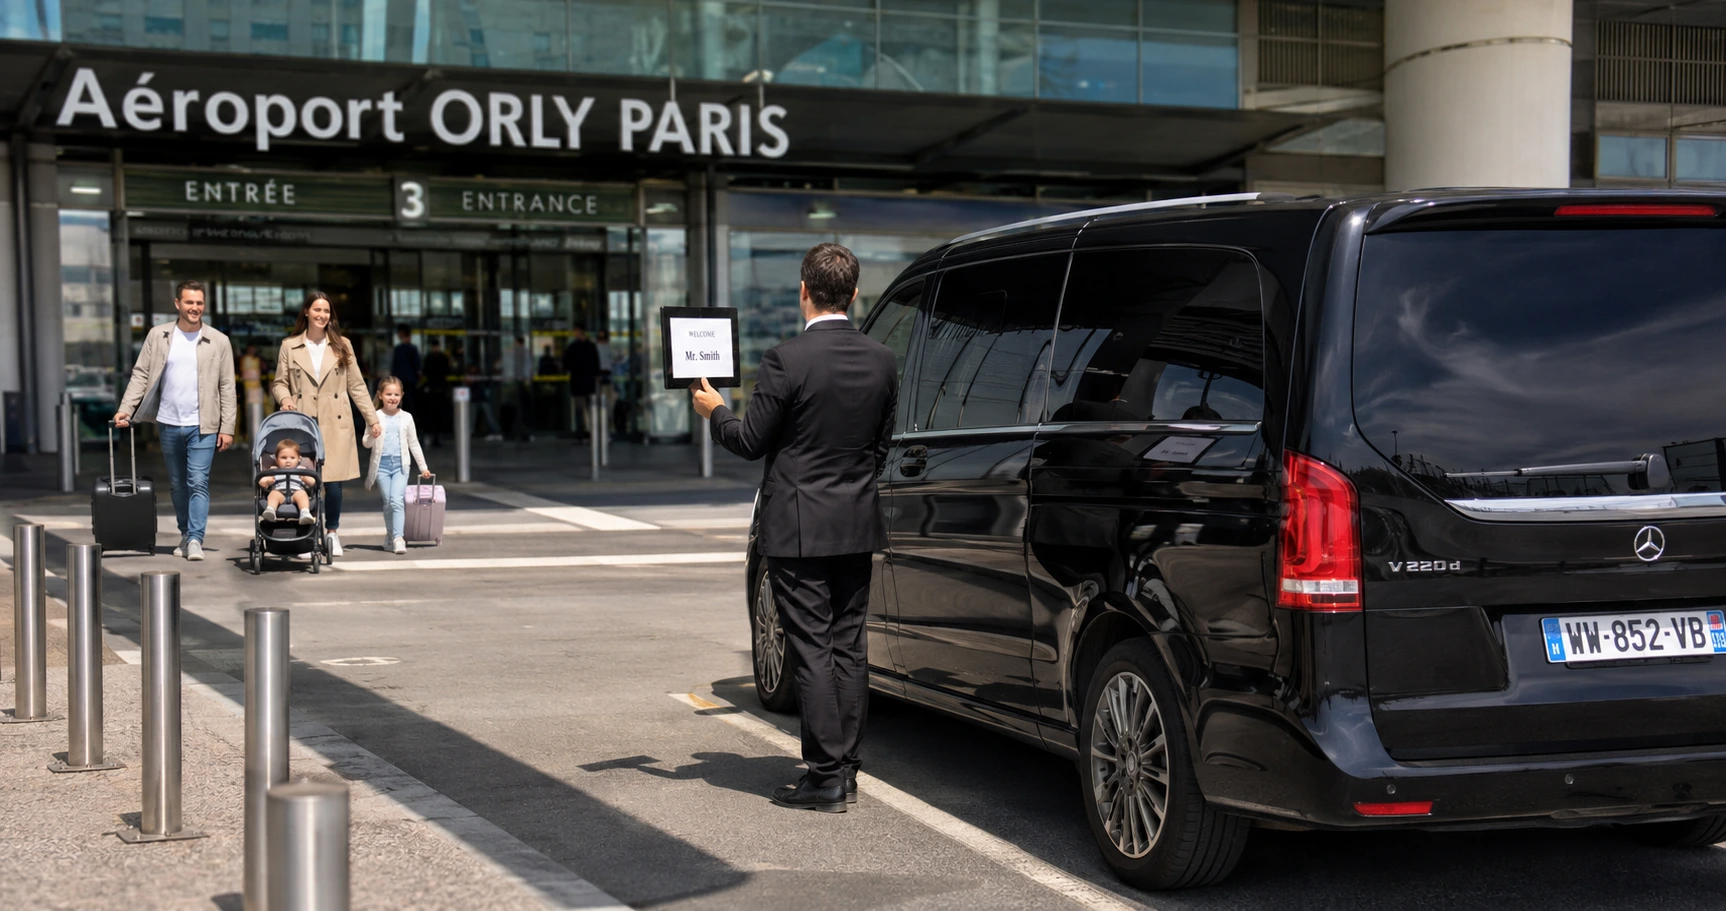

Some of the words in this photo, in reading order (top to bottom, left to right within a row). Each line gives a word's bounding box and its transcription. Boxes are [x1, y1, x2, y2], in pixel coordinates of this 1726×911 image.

[57, 68, 404, 152] Aéroport
[430, 89, 595, 149] ORLY
[620, 98, 789, 159] PARIS
[185, 180, 296, 205] ENTRÉE
[400, 181, 425, 219] 3
[462, 191, 597, 214] ENTRANCE
[688, 330, 716, 338] WELCOME
[685, 351, 698, 361] Mr.
[699, 350, 720, 361] Smith
[1388, 561, 1403, 573] V
[1406, 560, 1447, 572] 220
[1565, 616, 1706, 655] WW-852-VB
